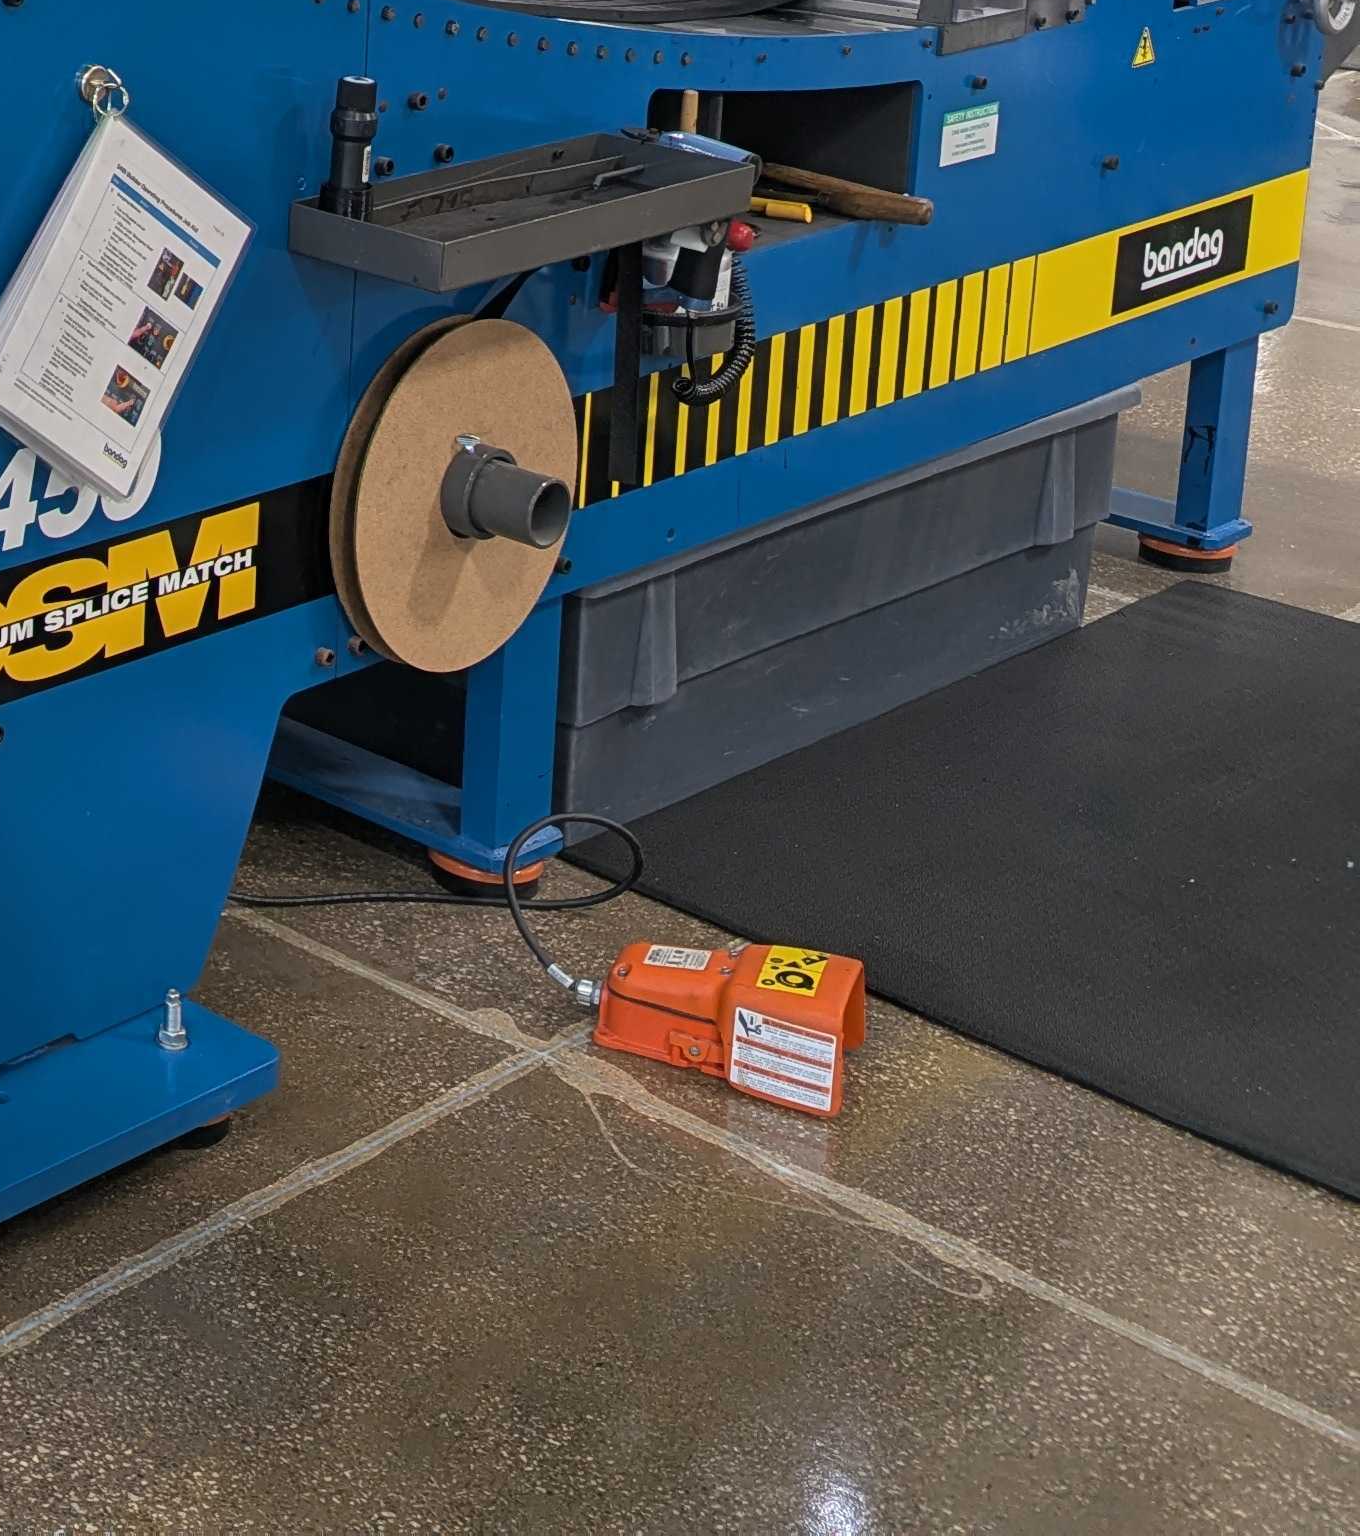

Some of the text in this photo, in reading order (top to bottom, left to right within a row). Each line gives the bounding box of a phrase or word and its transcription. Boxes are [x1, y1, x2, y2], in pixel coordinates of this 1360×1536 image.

[140, 183, 161, 204] Operating
[160, 199, 184, 221] Procedures
[1143, 226, 1224, 279] bandag
[103, 442, 128, 469] bandag
[43, 581, 150, 633] SPLICE
[158, 548, 253, 597] MATCH
